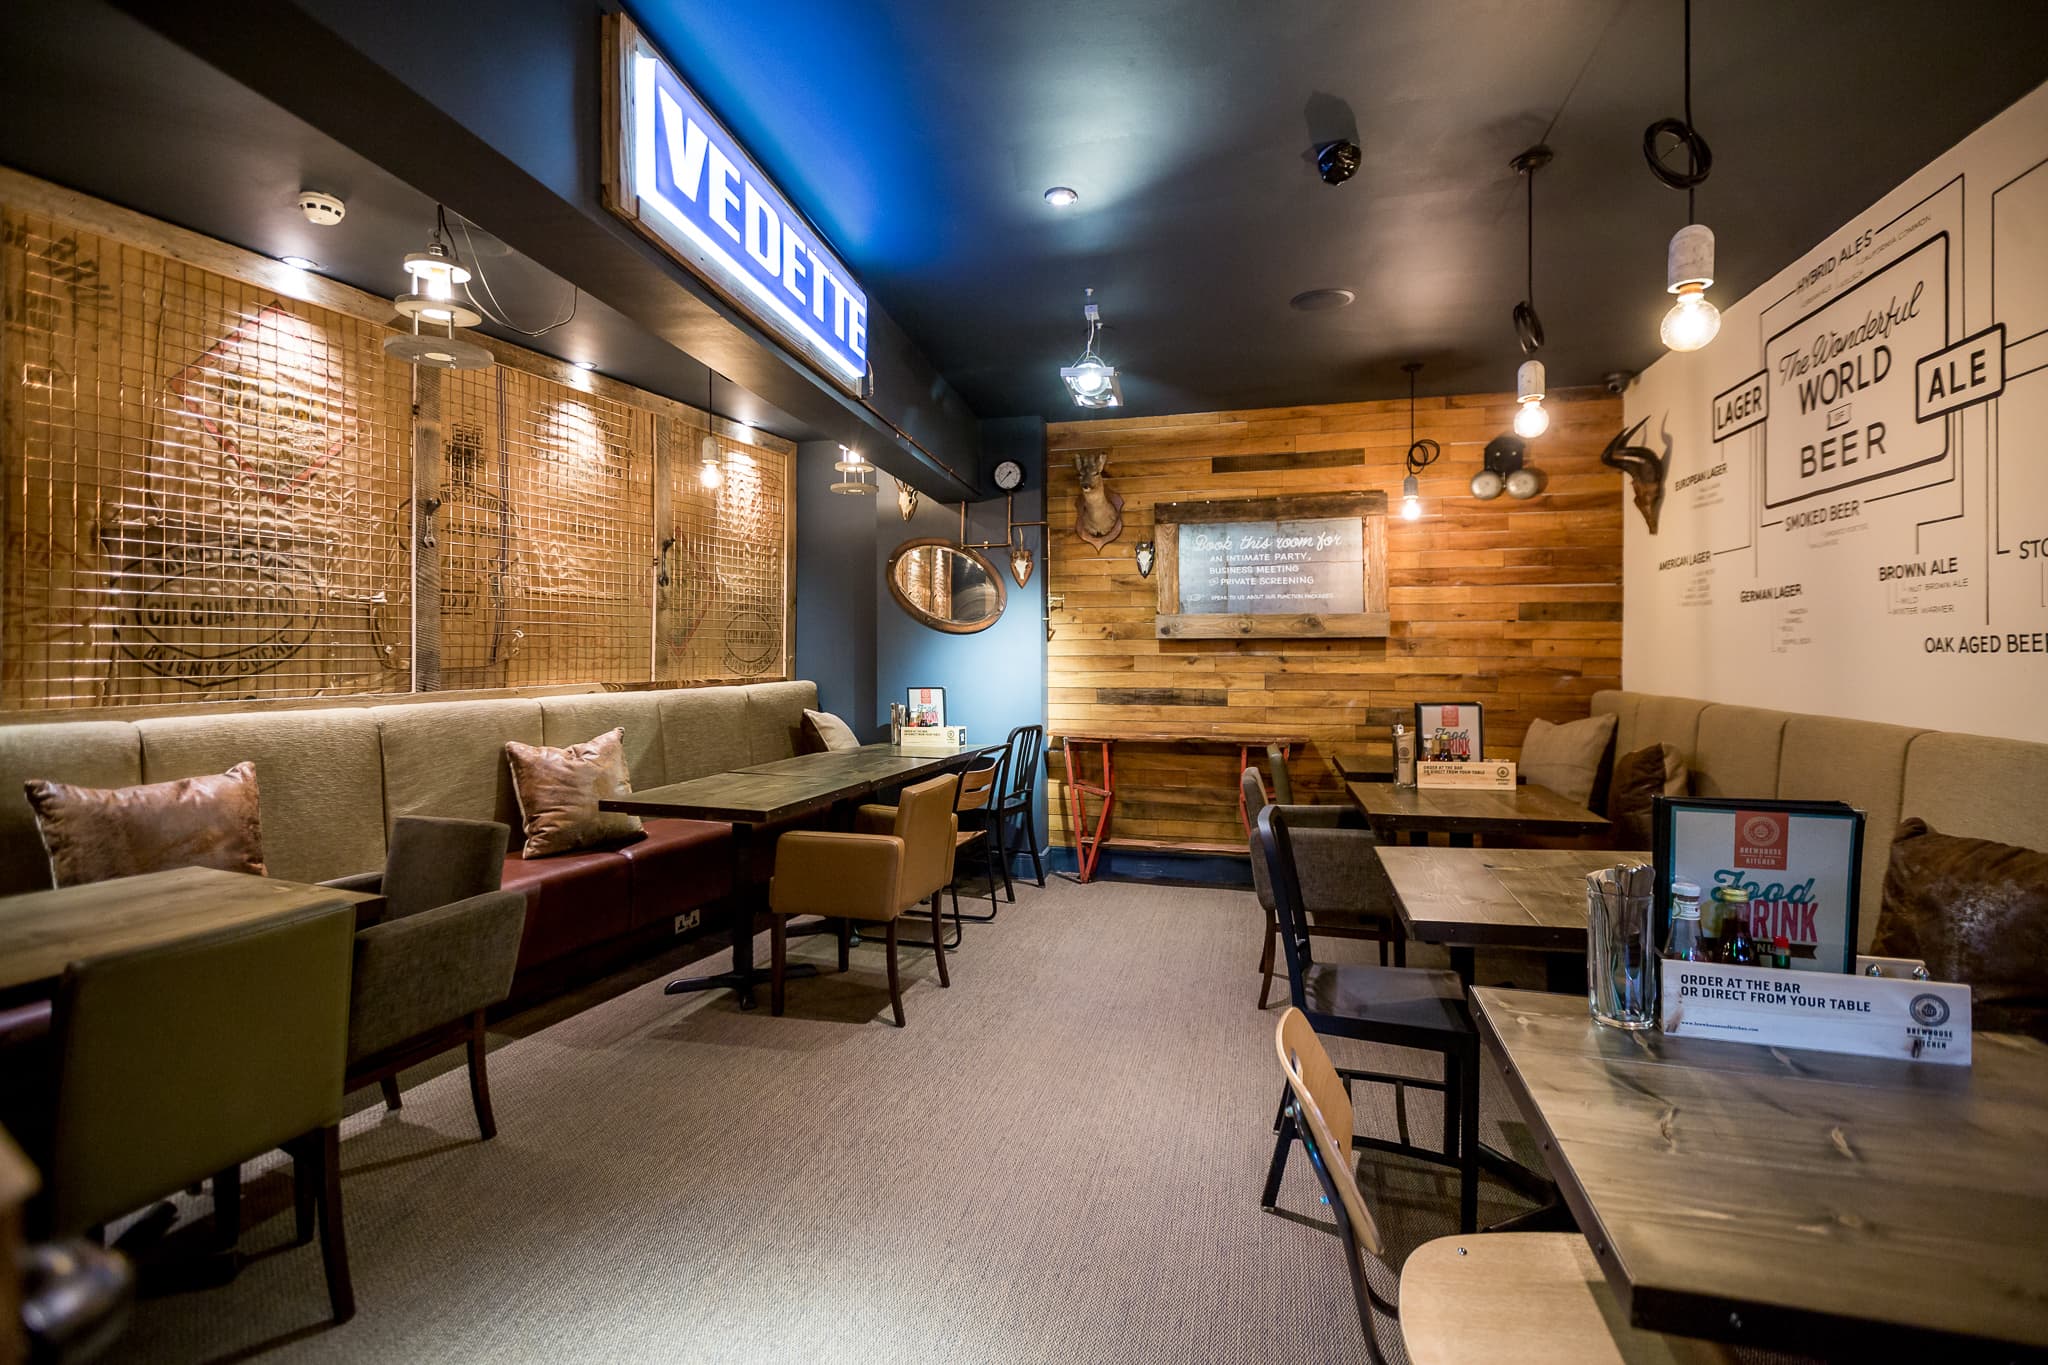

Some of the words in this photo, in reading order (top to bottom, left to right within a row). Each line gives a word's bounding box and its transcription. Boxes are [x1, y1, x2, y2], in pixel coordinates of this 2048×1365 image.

[658, 86, 866, 360] VEDETTE
[1837, 229, 1873, 267] ALES
[1779, 350, 1810, 386] The
[1811, 280, 1924, 369] Wonderful
[1799, 345, 1892, 416] WORLD
[1928, 349, 1987, 403] ALE
[1717, 386, 1763, 430] LAGER
[1800, 421, 1887, 478] BEER
[1706, 463, 1728, 481] LAGER
[1785, 508, 1828, 532] SMOKED
[1829, 500, 1860, 522] BEER
[1194, 534, 1233, 551] Book
[1239, 534, 1273, 550] this
[1276, 535, 1314, 549] room
[1316, 531, 1343, 551] for
[1209, 565, 1253, 575] BUSINESS
[1256, 564, 1300, 574] MEETING
[1210, 554, 1223, 562] AN
[1226, 553, 1271, 562] INTIMATE
[1274, 552, 1312, 561] PARTY,
[1659, 556, 1689, 571] AMERICAN
[1689, 551, 1712, 566] LAGER
[1879, 562, 1927, 581] BROWN
[1930, 557, 1958, 575] ALE
[1221, 577, 1257, 586] PRIVATE
[1259, 576, 1314, 585] SCREENING
[1740, 588, 1774, 603] GERMAN
[1774, 584, 1803, 600] LAGER
[1925, 637, 1955, 653] OAK
[1958, 635, 2001, 653] AGED
[1448, 738, 1471, 753] RINK
[1710, 869, 1816, 904] Food
[1745, 899, 1819, 942] RINK
[1681, 974, 1723, 987] ORDER
[1726, 978, 1742, 988] AT
[1746, 979, 1770, 991] THE
[1774, 982, 1801, 993] BAR
[1681, 986, 1698, 997] OR
[1702, 988, 1746, 1000] DIRECT
[1750, 992, 1786, 1005] FROM
[1790, 995, 1826, 1008] YOUR
[1829, 998, 1871, 1012] TABLE
